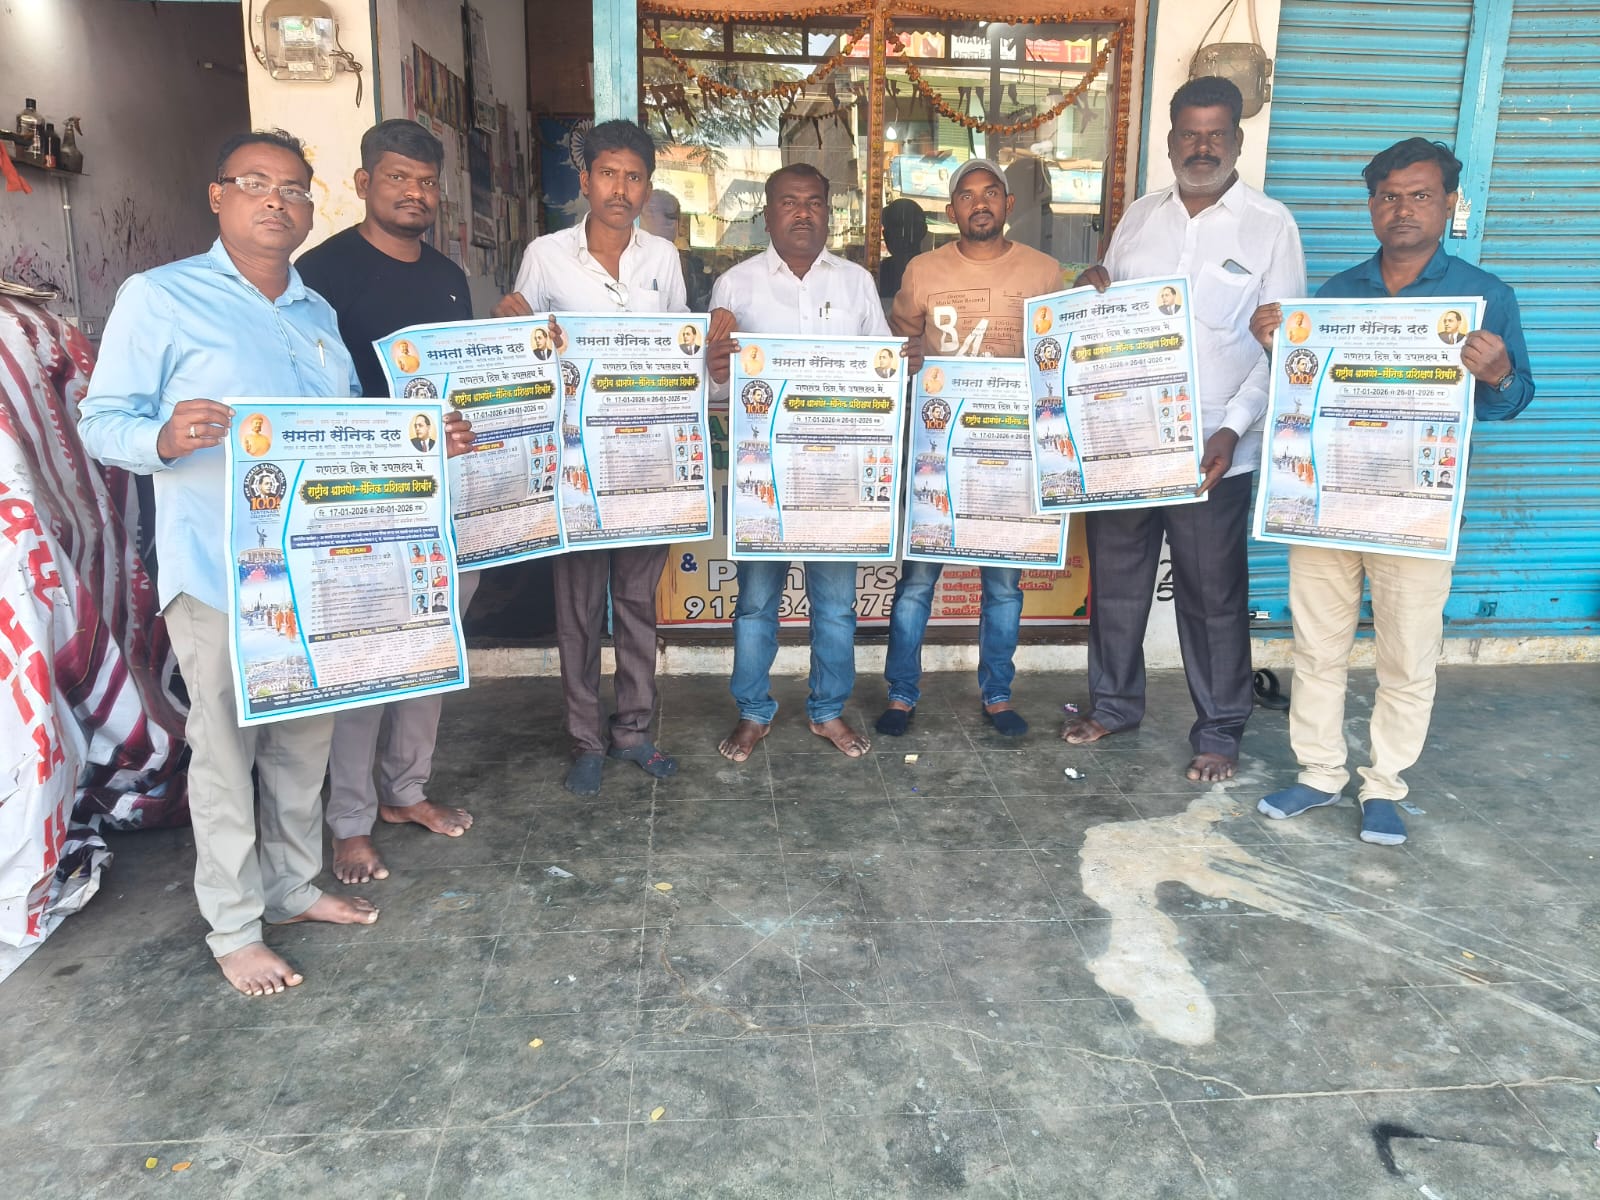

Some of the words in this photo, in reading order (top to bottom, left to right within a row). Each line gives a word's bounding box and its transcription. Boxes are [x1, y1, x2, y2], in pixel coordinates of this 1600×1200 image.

[1058, 309, 1087, 322] समता
[1091, 303, 1127, 318] सैनिक
[1131, 301, 1149, 311] दल
[1319, 324, 1354, 335] समता
[1360, 320, 1401, 335] सैनिक
[1407, 323, 1428, 335] दल
[576, 336, 609, 347] समता
[614, 333, 650, 347] सैनिक
[654, 336, 672, 347] दल
[427, 347, 461, 361] समता
[466, 342, 503, 358] सैनिक
[507, 342, 525, 353] दल
[1343, 352, 1371, 362] गणतंत्र
[1391, 350, 1400, 361] के
[1441, 351, 1450, 361] में
[646, 360, 653, 370] के
[772, 357, 805, 368] समता
[809, 355, 845, 369] सैनिक
[849, 359, 868, 370] दल
[502, 370, 509, 380] के
[839, 383, 846, 392] के
[877, 383, 885, 394] में
[951, 377, 982, 388] समता
[986, 376, 1021, 389] सैनिक
[1353, 388, 1389, 396] 17-01-2026
[1396, 389, 1435, 397] 26-01-2026
[473, 408, 502, 420] 17-01-2026
[282, 429, 326, 444] समता
[330, 426, 375, 443] सैनिक
[380, 429, 401, 442] दल
[315, 461, 347, 475] गणतंत्र
[370, 460, 379, 473] के
[415, 459, 425, 473] में
[307, 483, 329, 499] राष्ट्रीय
[384, 480, 411, 495] प्रशिक्षण
[329, 505, 368, 517] 17-01-2026
[376, 503, 414, 514] 26-01-2026
[681, 553, 698, 573] &
